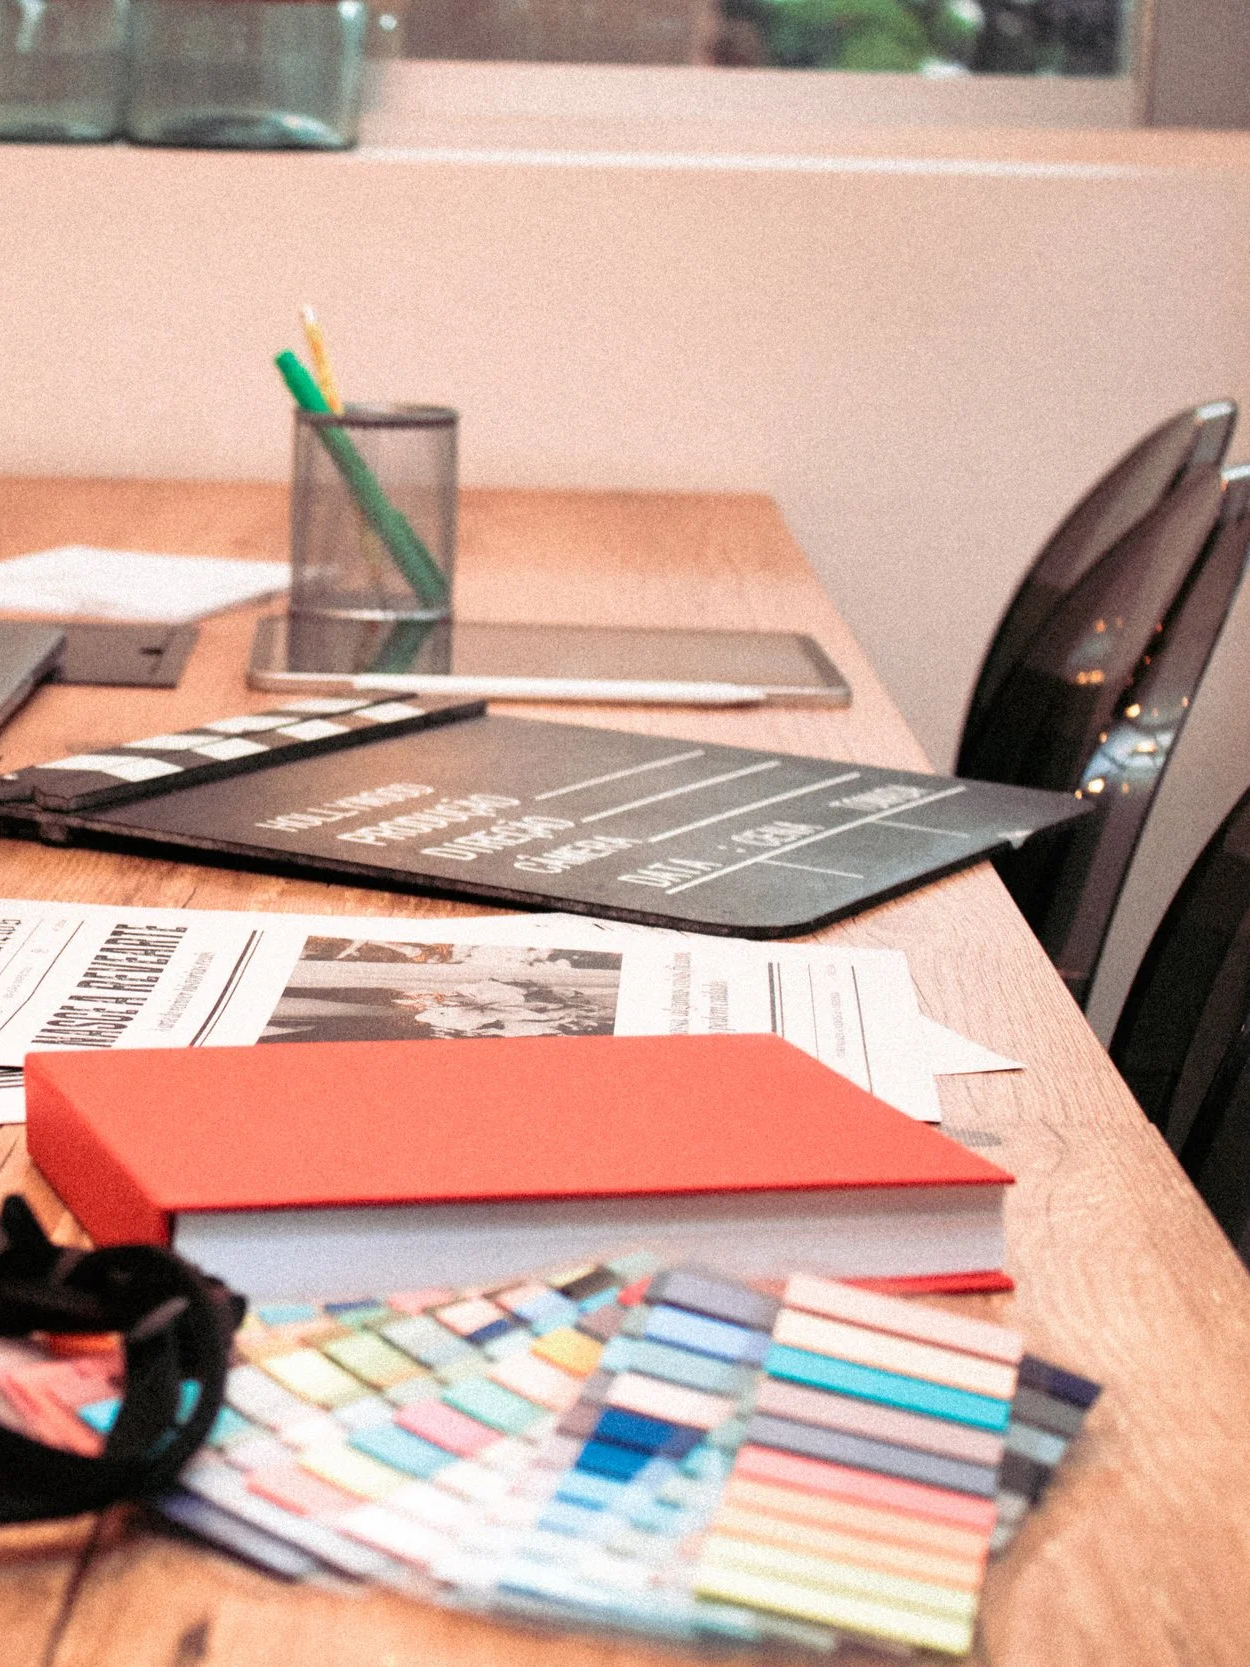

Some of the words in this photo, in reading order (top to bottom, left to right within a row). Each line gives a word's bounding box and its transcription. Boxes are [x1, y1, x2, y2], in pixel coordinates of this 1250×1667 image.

[617, 857, 723, 888] DATA
[67, 994, 149, 1006] A
[30, 1004, 140, 1047] NASCE
